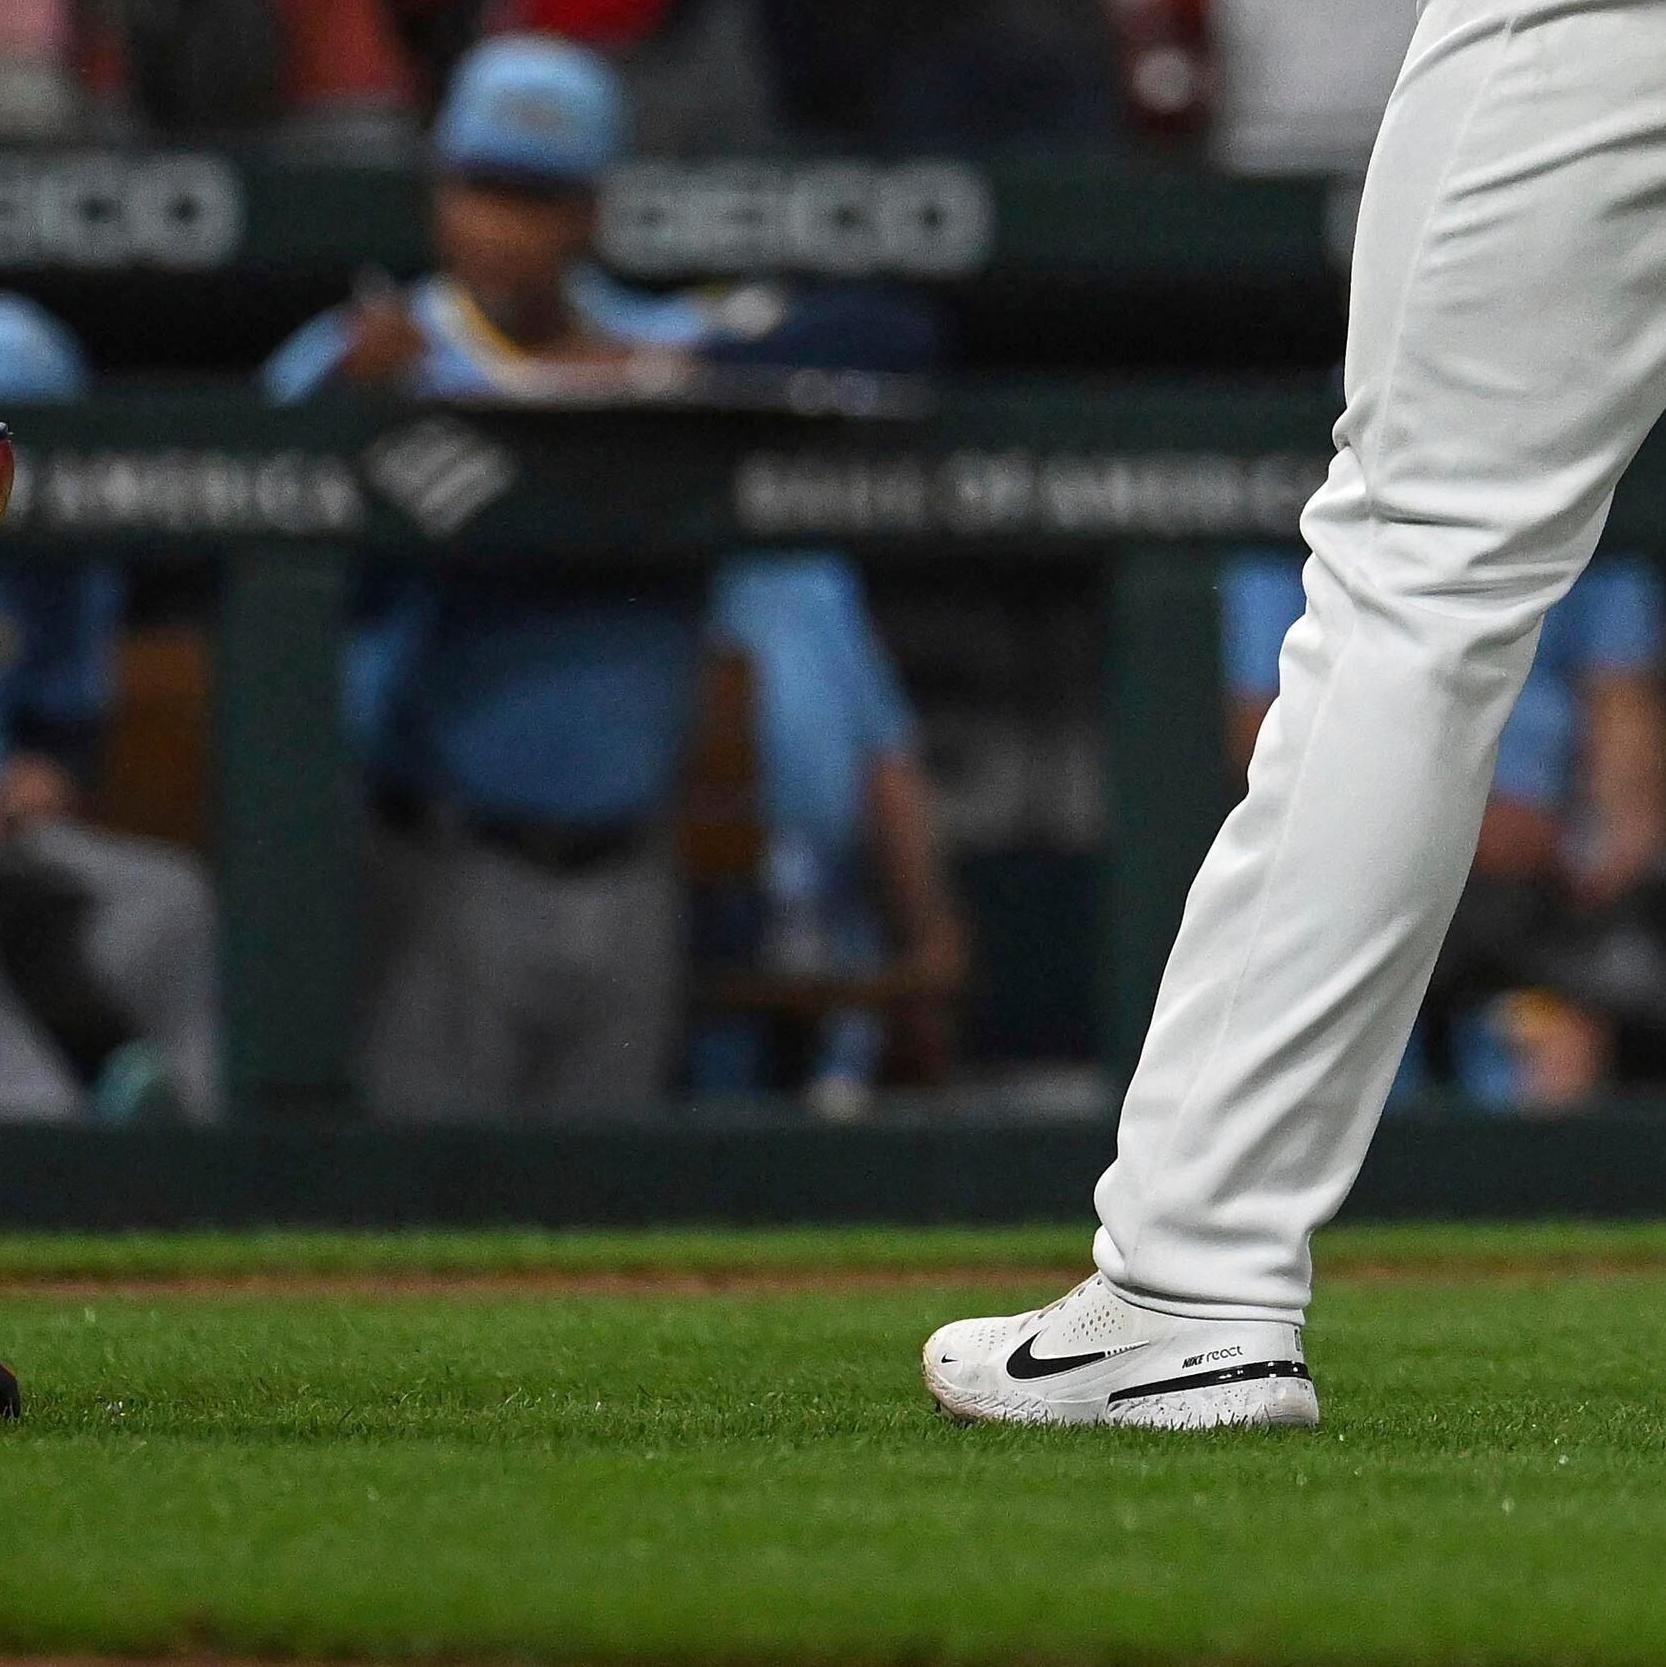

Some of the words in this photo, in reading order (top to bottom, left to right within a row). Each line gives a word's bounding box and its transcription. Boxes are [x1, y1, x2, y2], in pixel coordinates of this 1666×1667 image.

[596, 162, 993, 274] GEICO
[1181, 1354, 1205, 1369] NIKE
[1206, 1346, 1243, 1363] react
